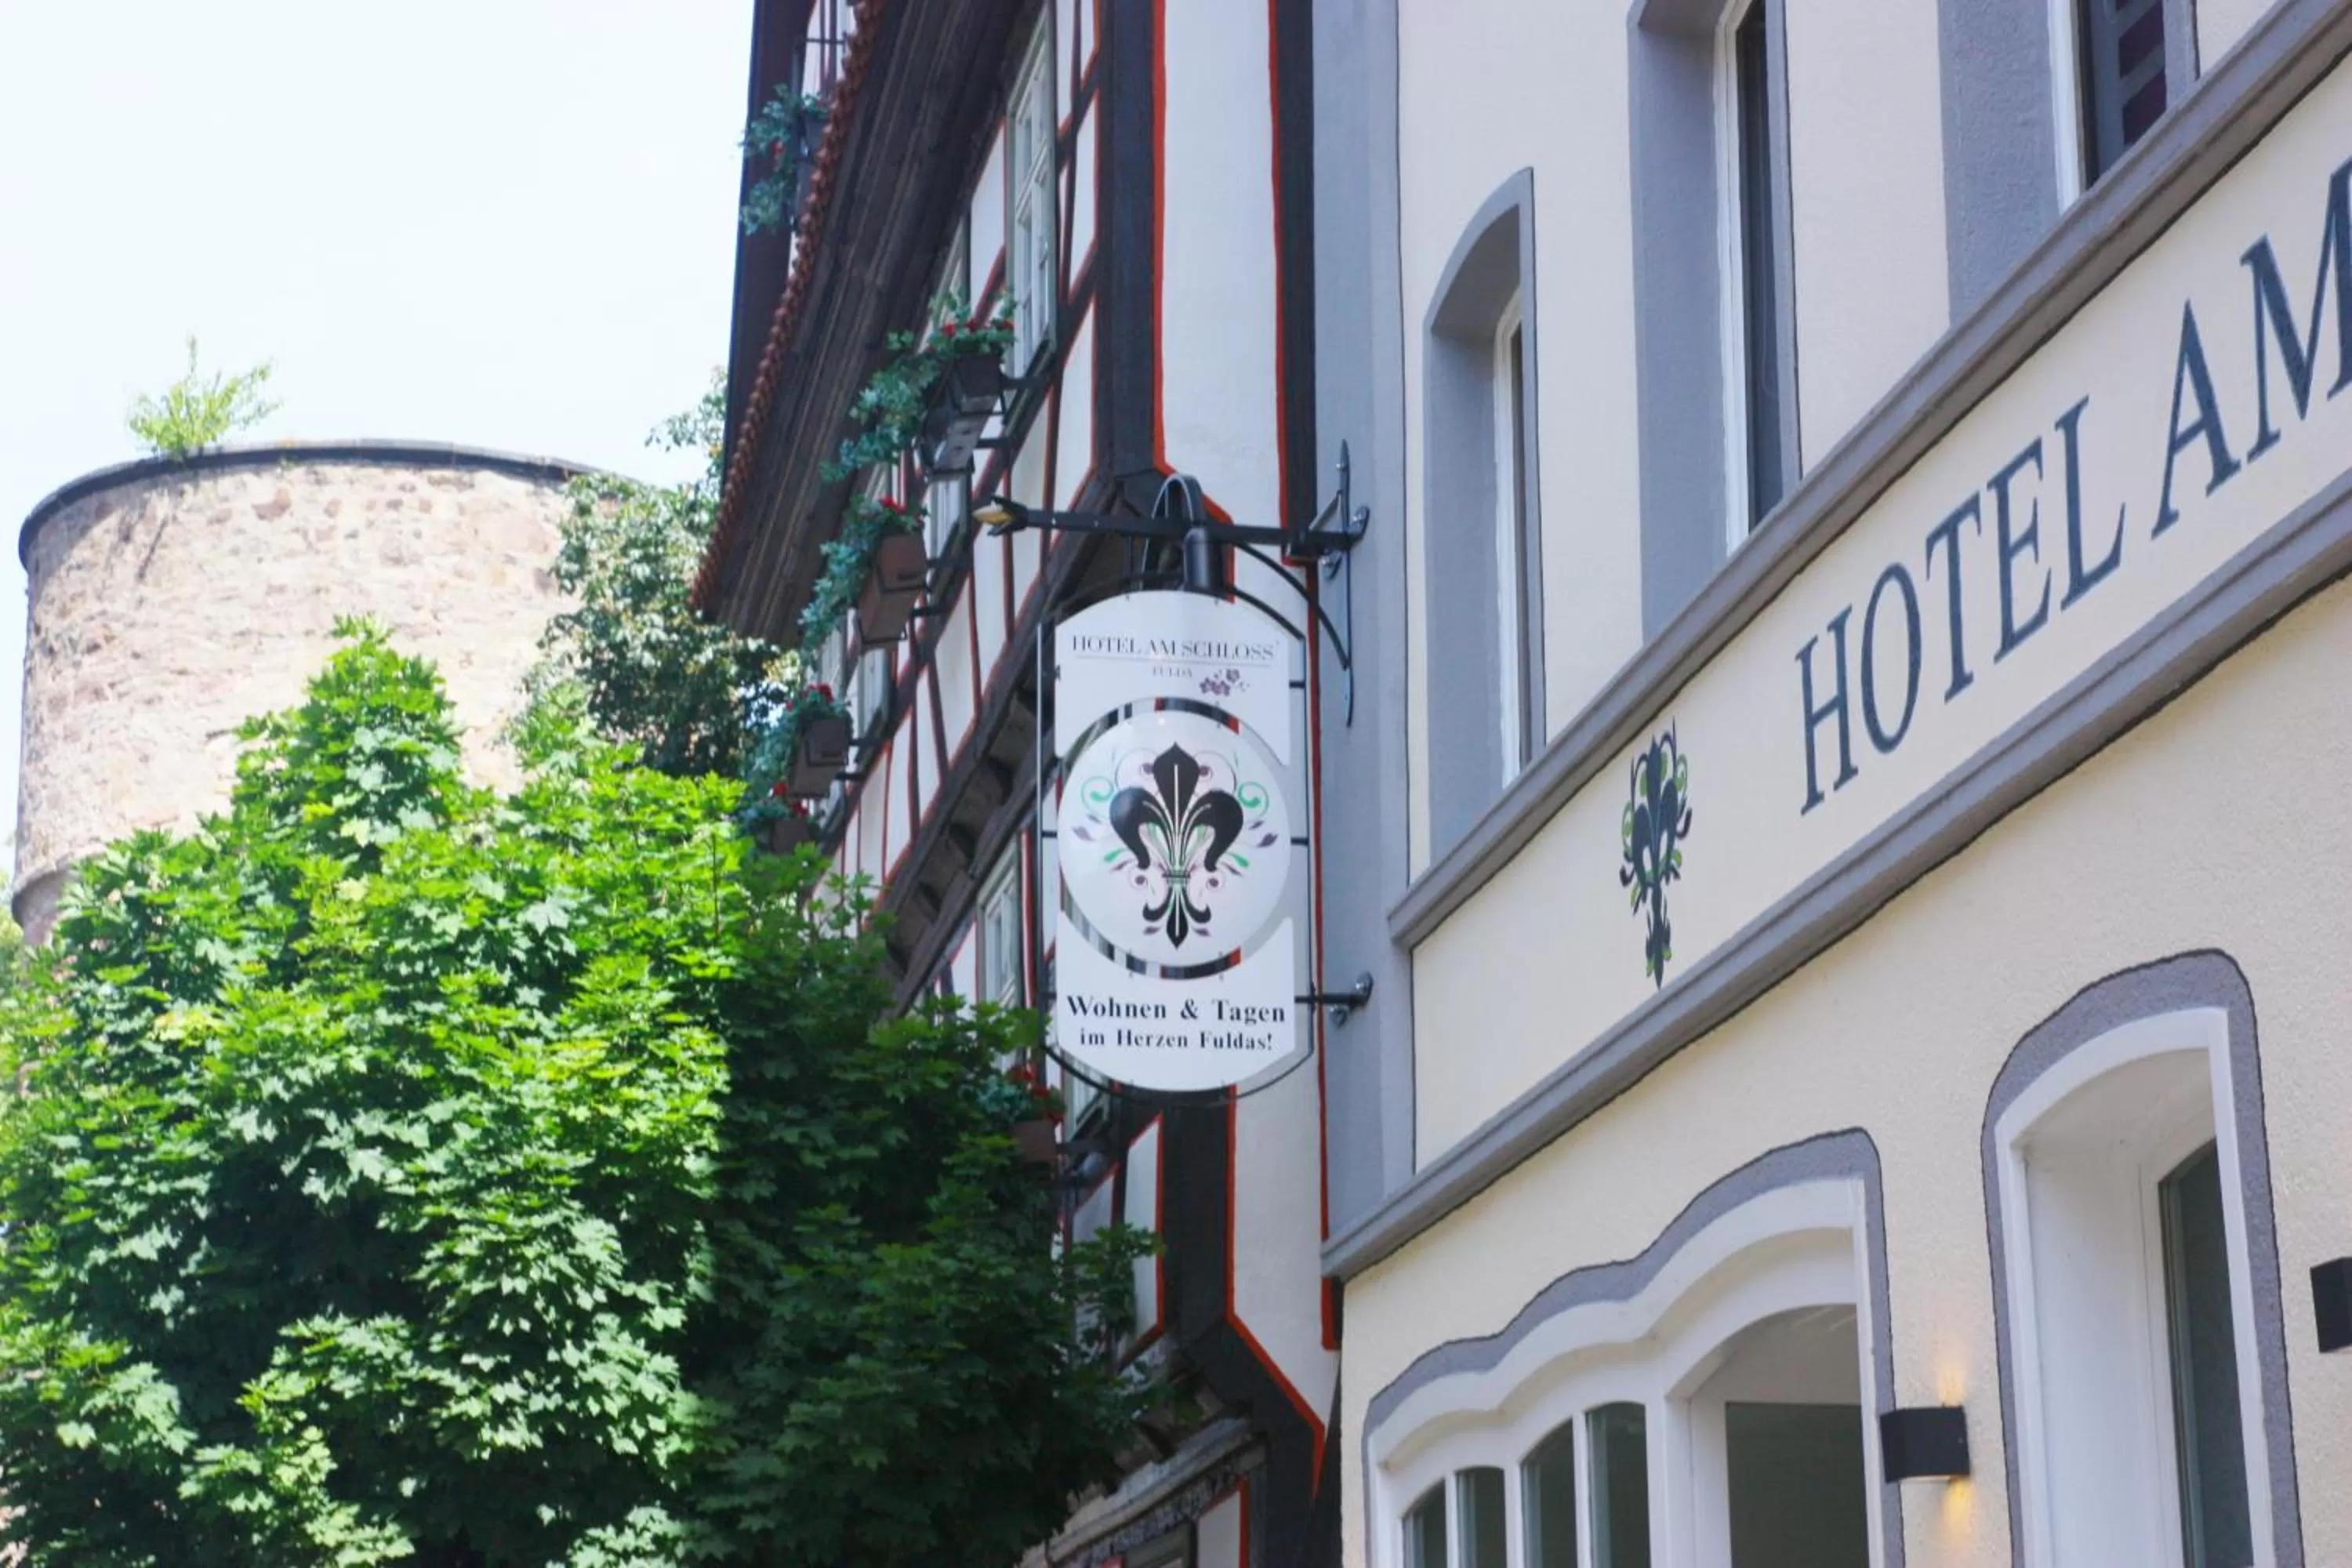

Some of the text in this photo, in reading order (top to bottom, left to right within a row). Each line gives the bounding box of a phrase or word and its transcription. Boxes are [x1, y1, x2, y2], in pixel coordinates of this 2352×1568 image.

[1795, 155, 2352, 816] HOTEL AM
[1072, 634, 1275, 659] HOTEL AM SCHLOSS
[1067, 995, 1285, 1025] Wohnen & Tagen
[1080, 1028, 1272, 1051] im Herzen Fuldas!
